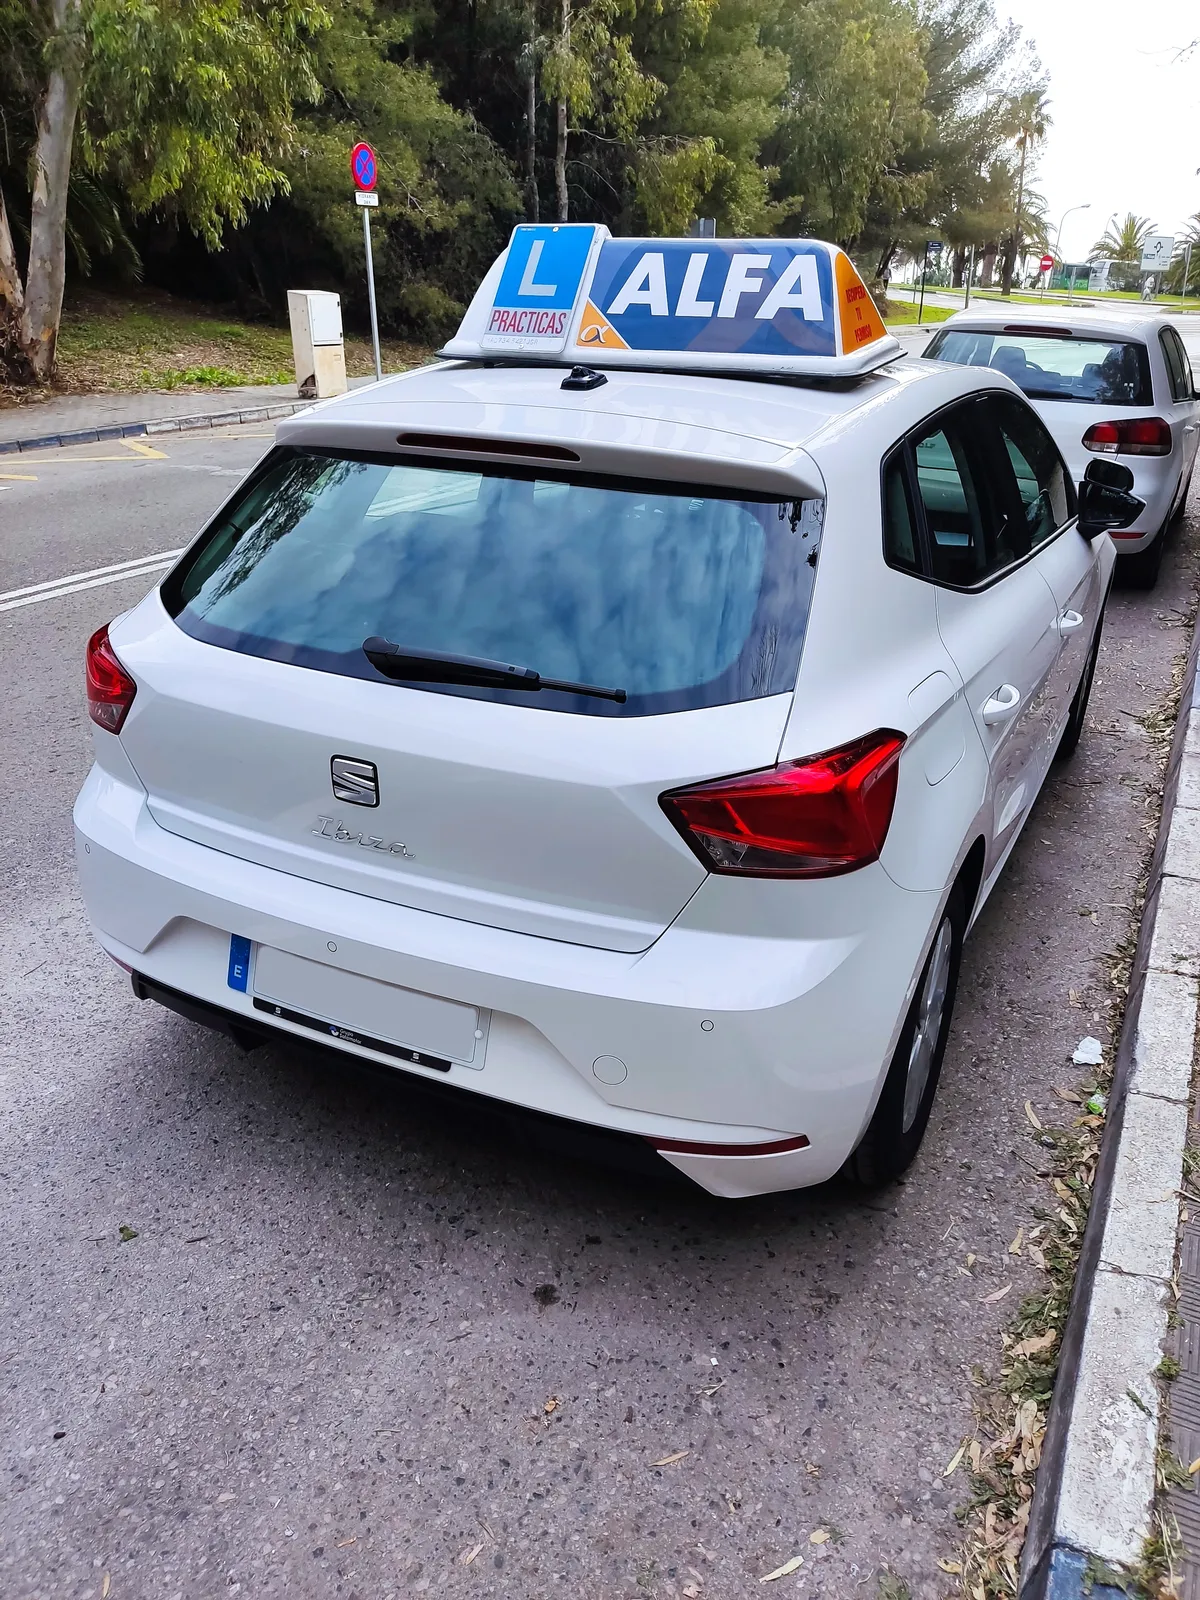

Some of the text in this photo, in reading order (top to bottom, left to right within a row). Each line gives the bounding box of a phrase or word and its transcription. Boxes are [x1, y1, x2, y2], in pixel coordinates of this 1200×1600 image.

[517, 240, 557, 297] L
[606, 251, 825, 321] ALFA
[489, 309, 567, 335] PRACTICAS
[311, 814, 416, 860] Ibiza
[234, 964, 243, 978] E
